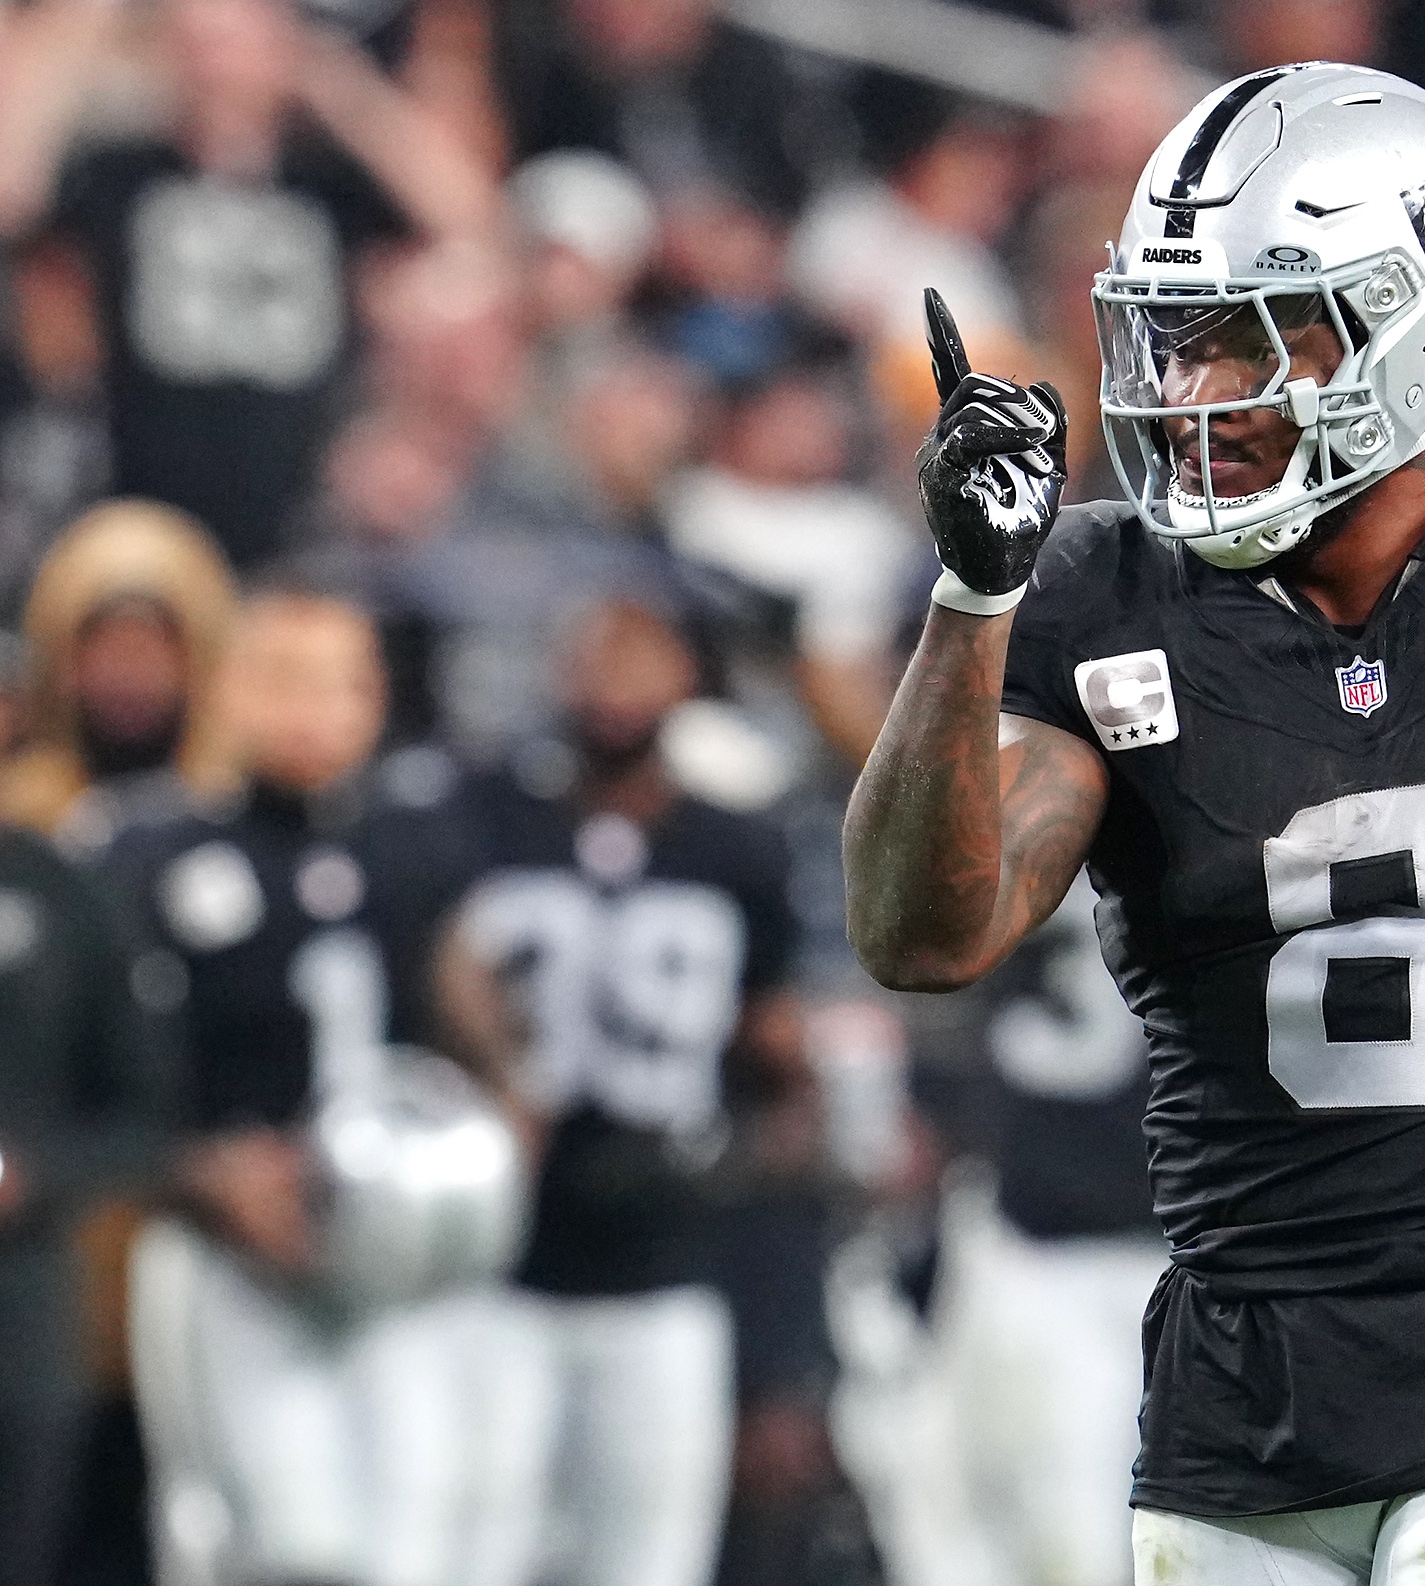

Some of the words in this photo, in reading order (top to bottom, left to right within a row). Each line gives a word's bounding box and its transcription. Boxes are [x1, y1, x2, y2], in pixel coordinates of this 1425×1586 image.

[1142, 247, 1202, 264] RAIDERS
[1255, 261, 1317, 273] OAKLEY
[1086, 660, 1165, 728] C
[1347, 682, 1381, 708] NFL
